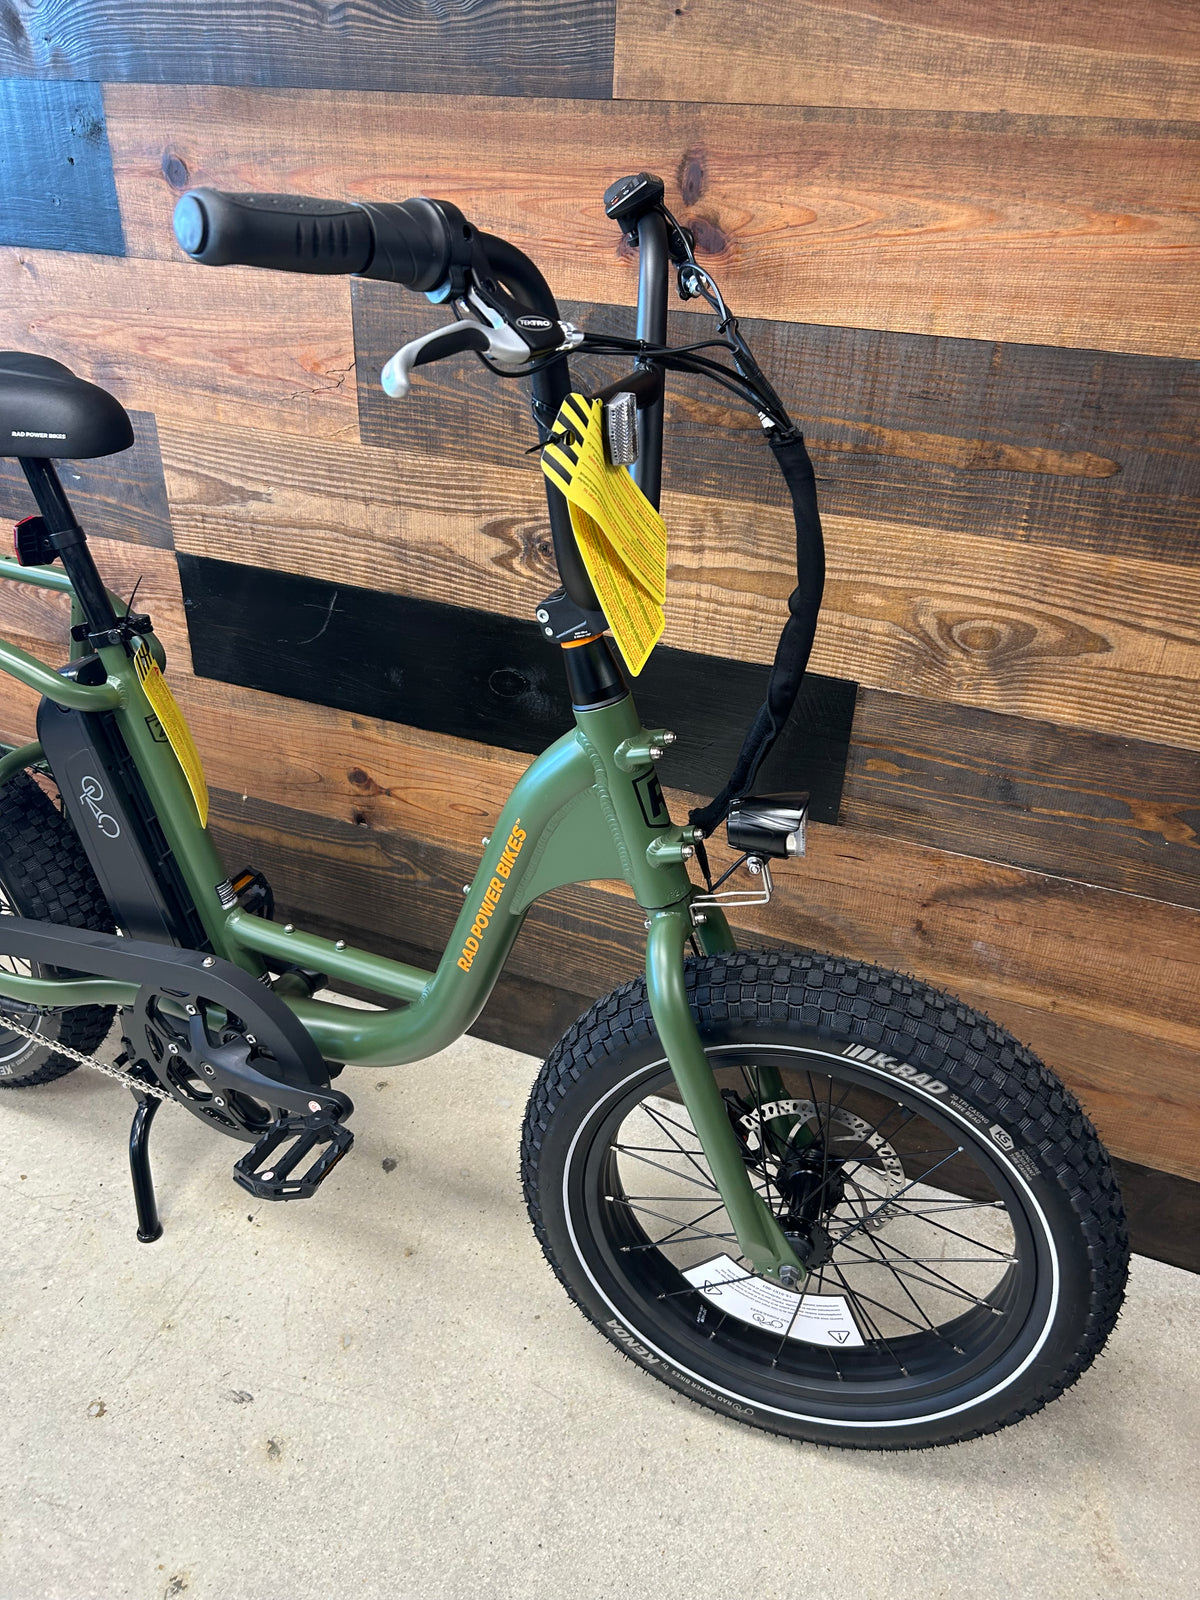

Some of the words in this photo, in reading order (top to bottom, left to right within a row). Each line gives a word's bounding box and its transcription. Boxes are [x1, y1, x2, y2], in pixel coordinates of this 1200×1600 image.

[457, 936, 480, 973] RAD
[470, 876, 506, 940] POWER
[606, 1318, 661, 1365] KENDA
[671, 1369, 691, 1384] BIKES
[690, 1383, 718, 1399] POWER
[717, 1396, 733, 1407] RAD
